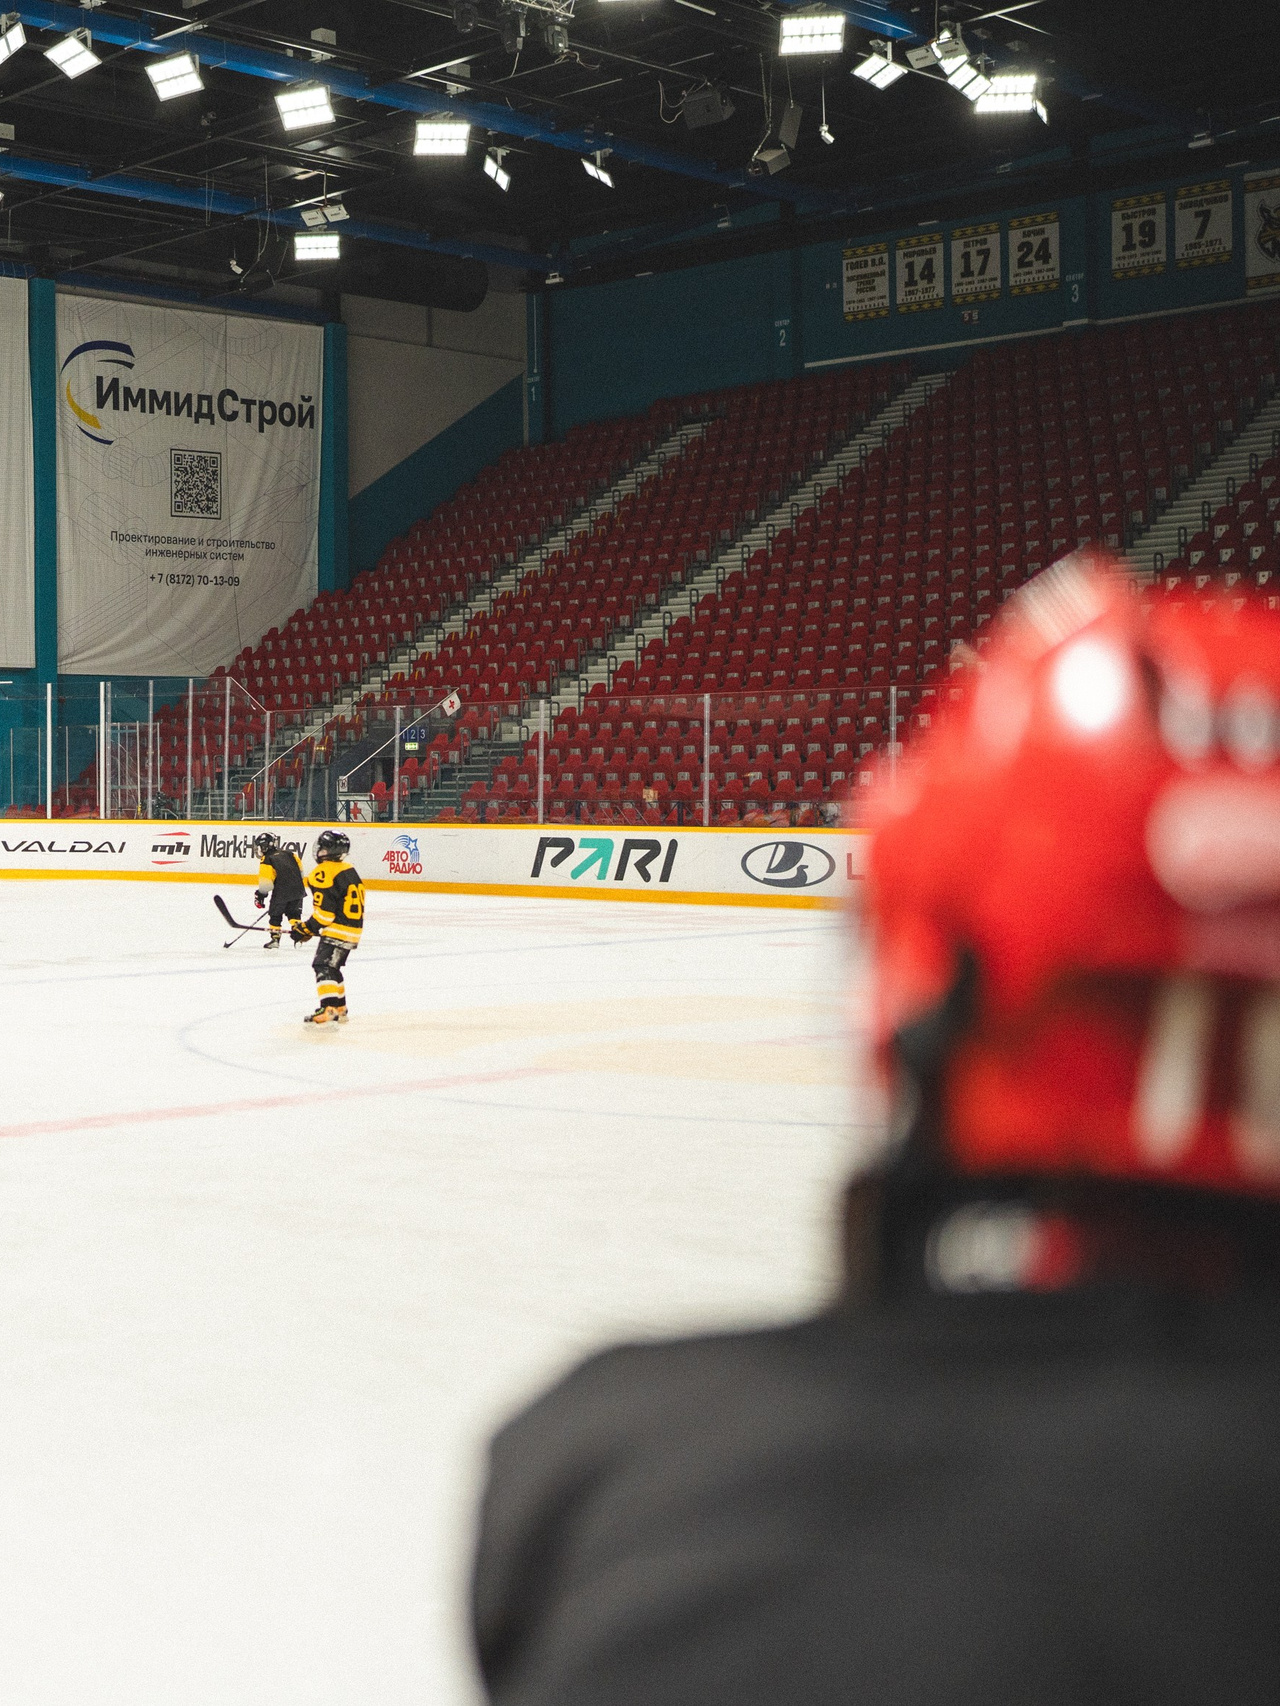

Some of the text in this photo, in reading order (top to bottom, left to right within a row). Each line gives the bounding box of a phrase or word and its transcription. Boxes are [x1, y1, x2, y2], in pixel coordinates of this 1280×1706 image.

[1121, 207, 1156, 220] БЫСТРОВ
[1194, 209, 1211, 240] 7
[1121, 219, 1156, 252] 19
[1017, 237, 1052, 270] 24
[904, 257, 936, 288] 14
[960, 248, 990, 279] 17
[1071, 283, 1079, 303] 3
[779, 329, 786, 347] 2
[96, 375, 315, 433] ИммидСтрой
[110, 531, 196, 546] Проектирование
[206, 538, 275, 550] строительство
[145, 548, 244, 561] инженерных систем
[158, 573, 163, 583] 7
[166, 573, 195, 587] (8172)
[197, 575, 240, 586] 70-13-09
[409, 730, 416, 740] 2
[420, 730, 426, 740] 3
[1, 840, 126, 853] VALDAI
[200, 834, 308, 861] MarkHkey
[382, 850, 409, 862] АВТО
[389, 862, 423, 875] РАДИО
[530, 836, 678, 883] PARI
